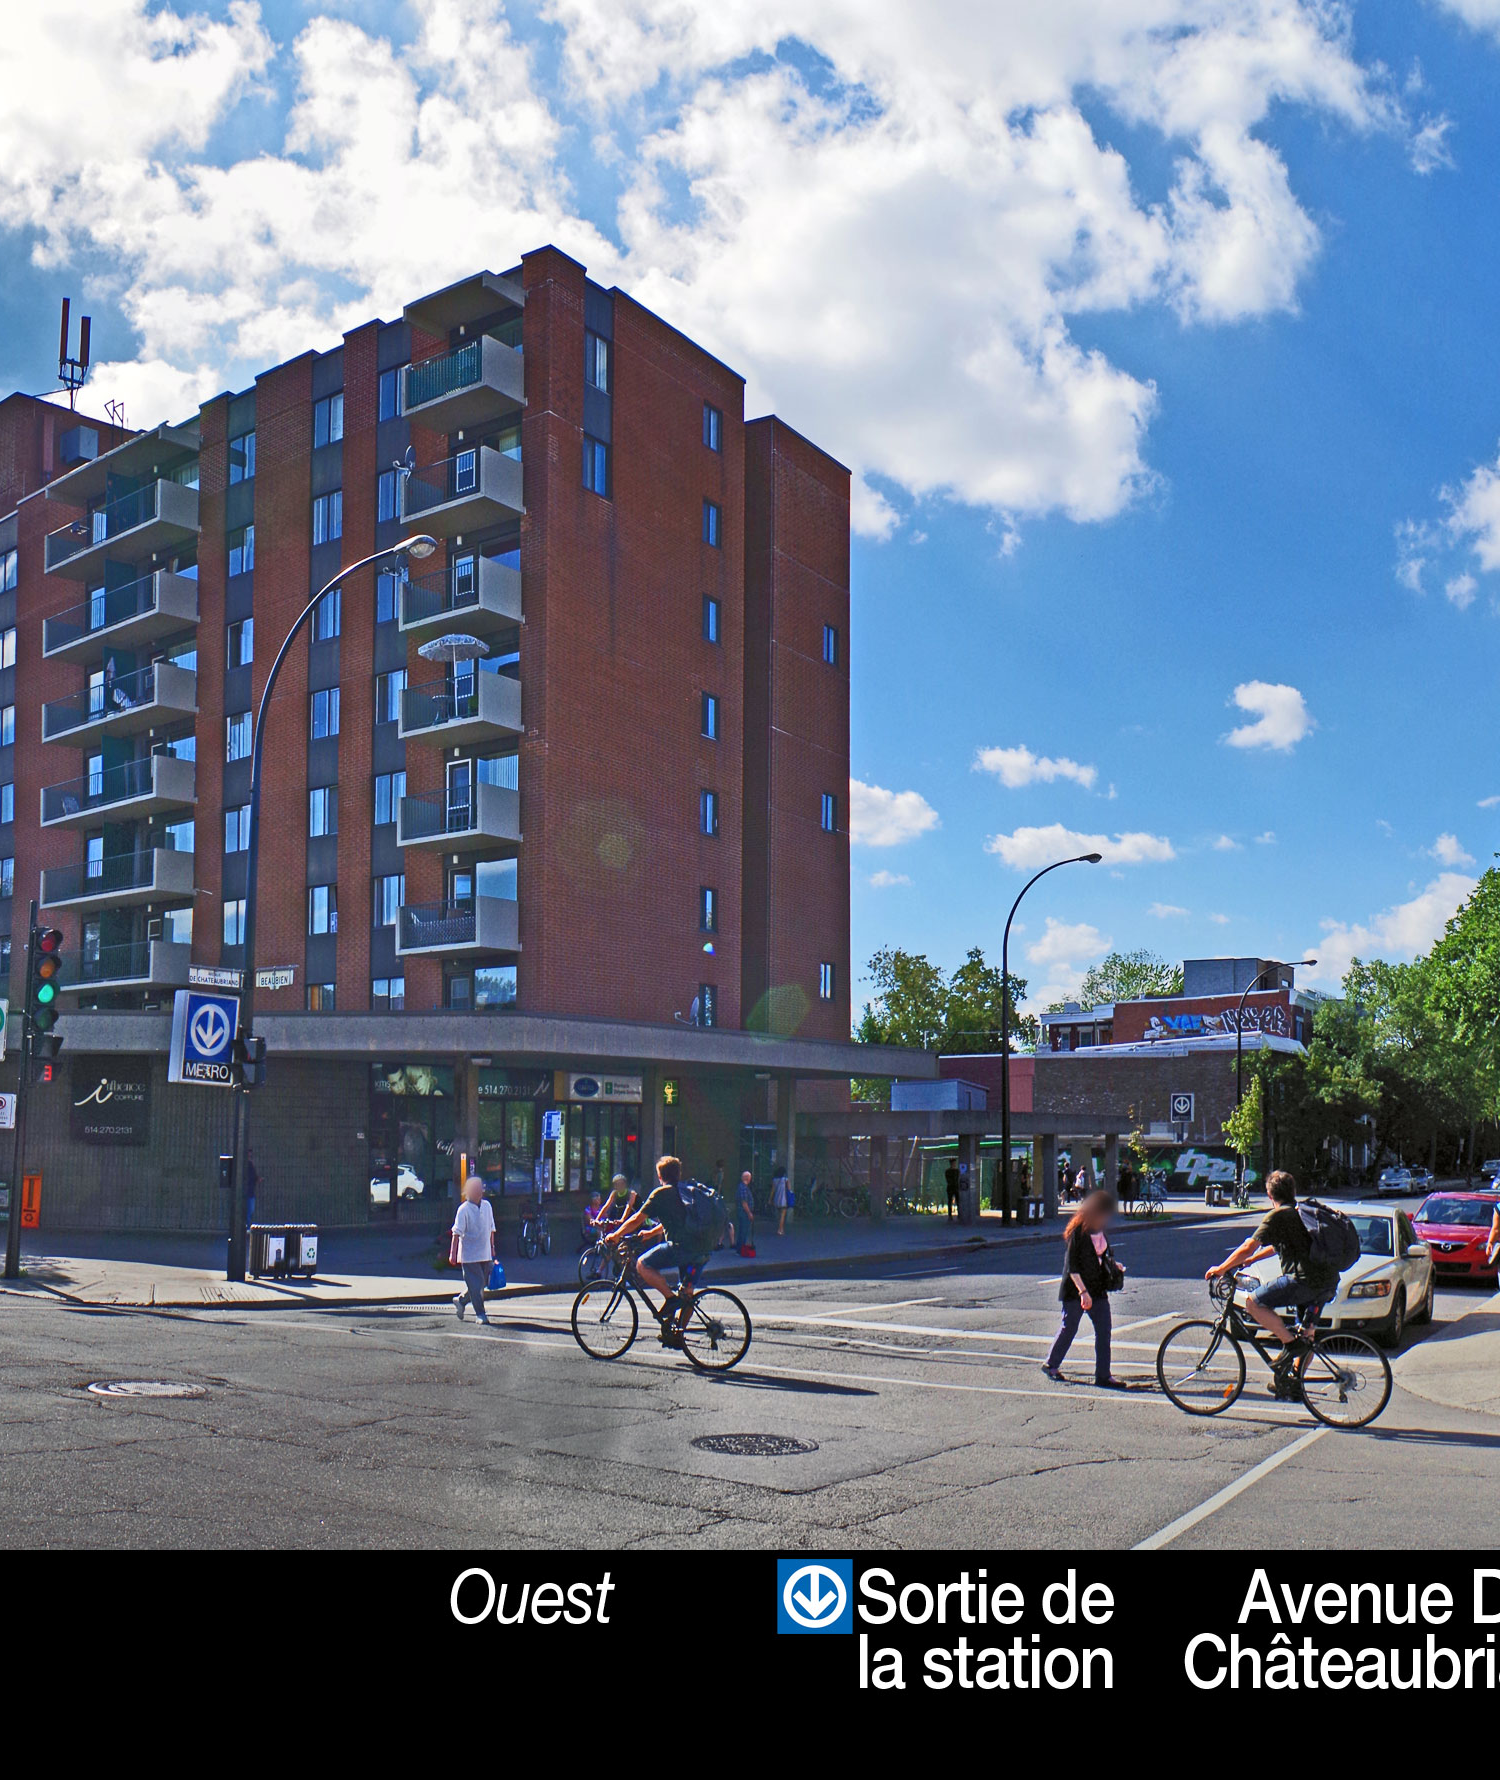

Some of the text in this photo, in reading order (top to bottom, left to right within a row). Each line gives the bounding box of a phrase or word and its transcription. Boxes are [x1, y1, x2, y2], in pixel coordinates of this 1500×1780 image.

[261, 976, 288, 985] BEAUBIEN
[185, 1062, 229, 1079] METRO
[484, 1085, 531, 1095] 514.270.2131
